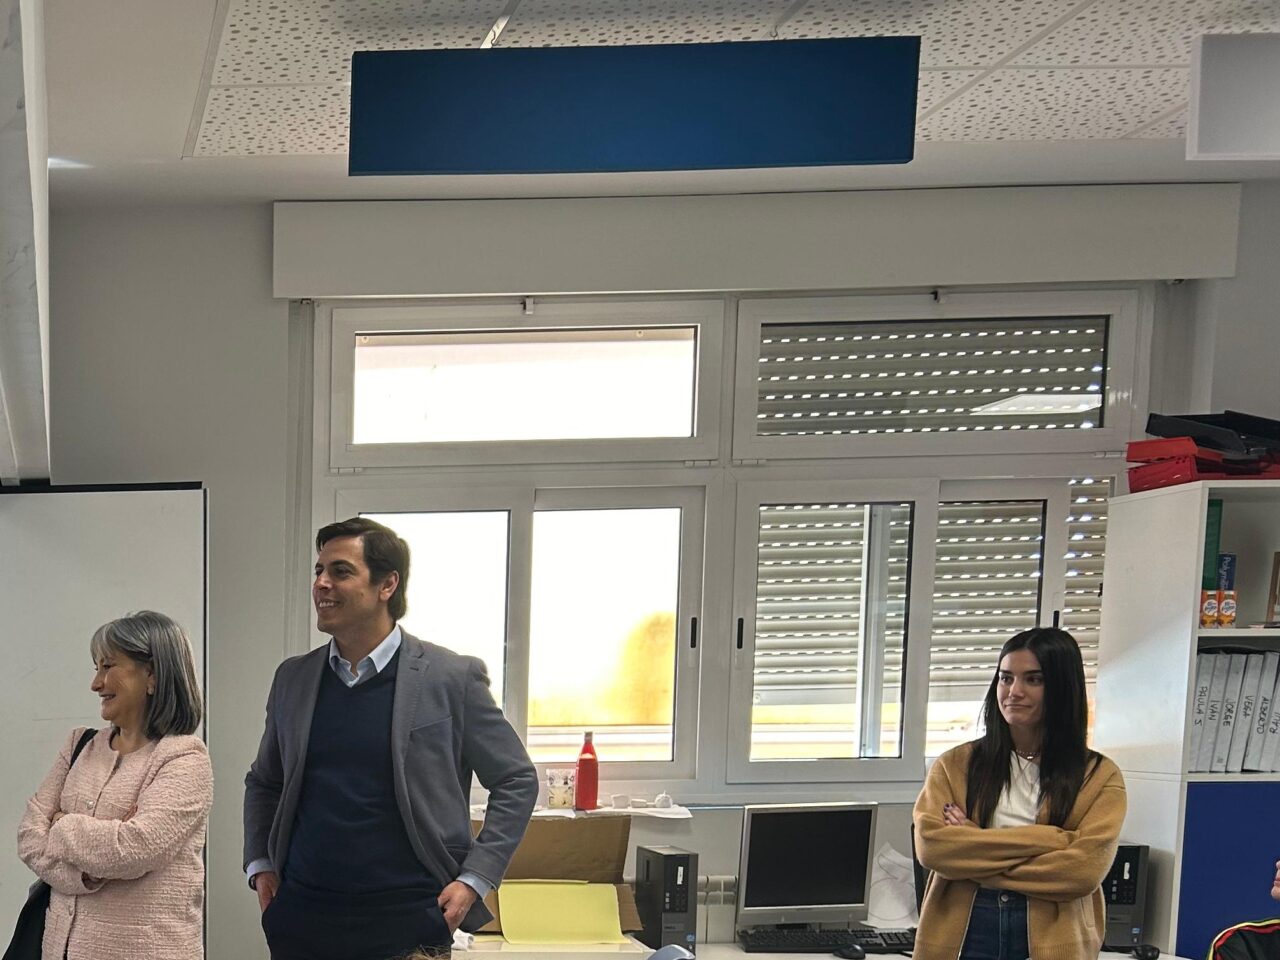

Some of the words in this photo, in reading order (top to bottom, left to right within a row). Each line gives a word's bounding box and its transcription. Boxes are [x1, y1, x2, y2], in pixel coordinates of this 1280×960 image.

[1196, 686, 1209, 715] PAULA
[1223, 698, 1237, 727] JORGE
[1243, 695, 1256, 719] VEGA
[1257, 695, 1269, 735] ALBERTO
